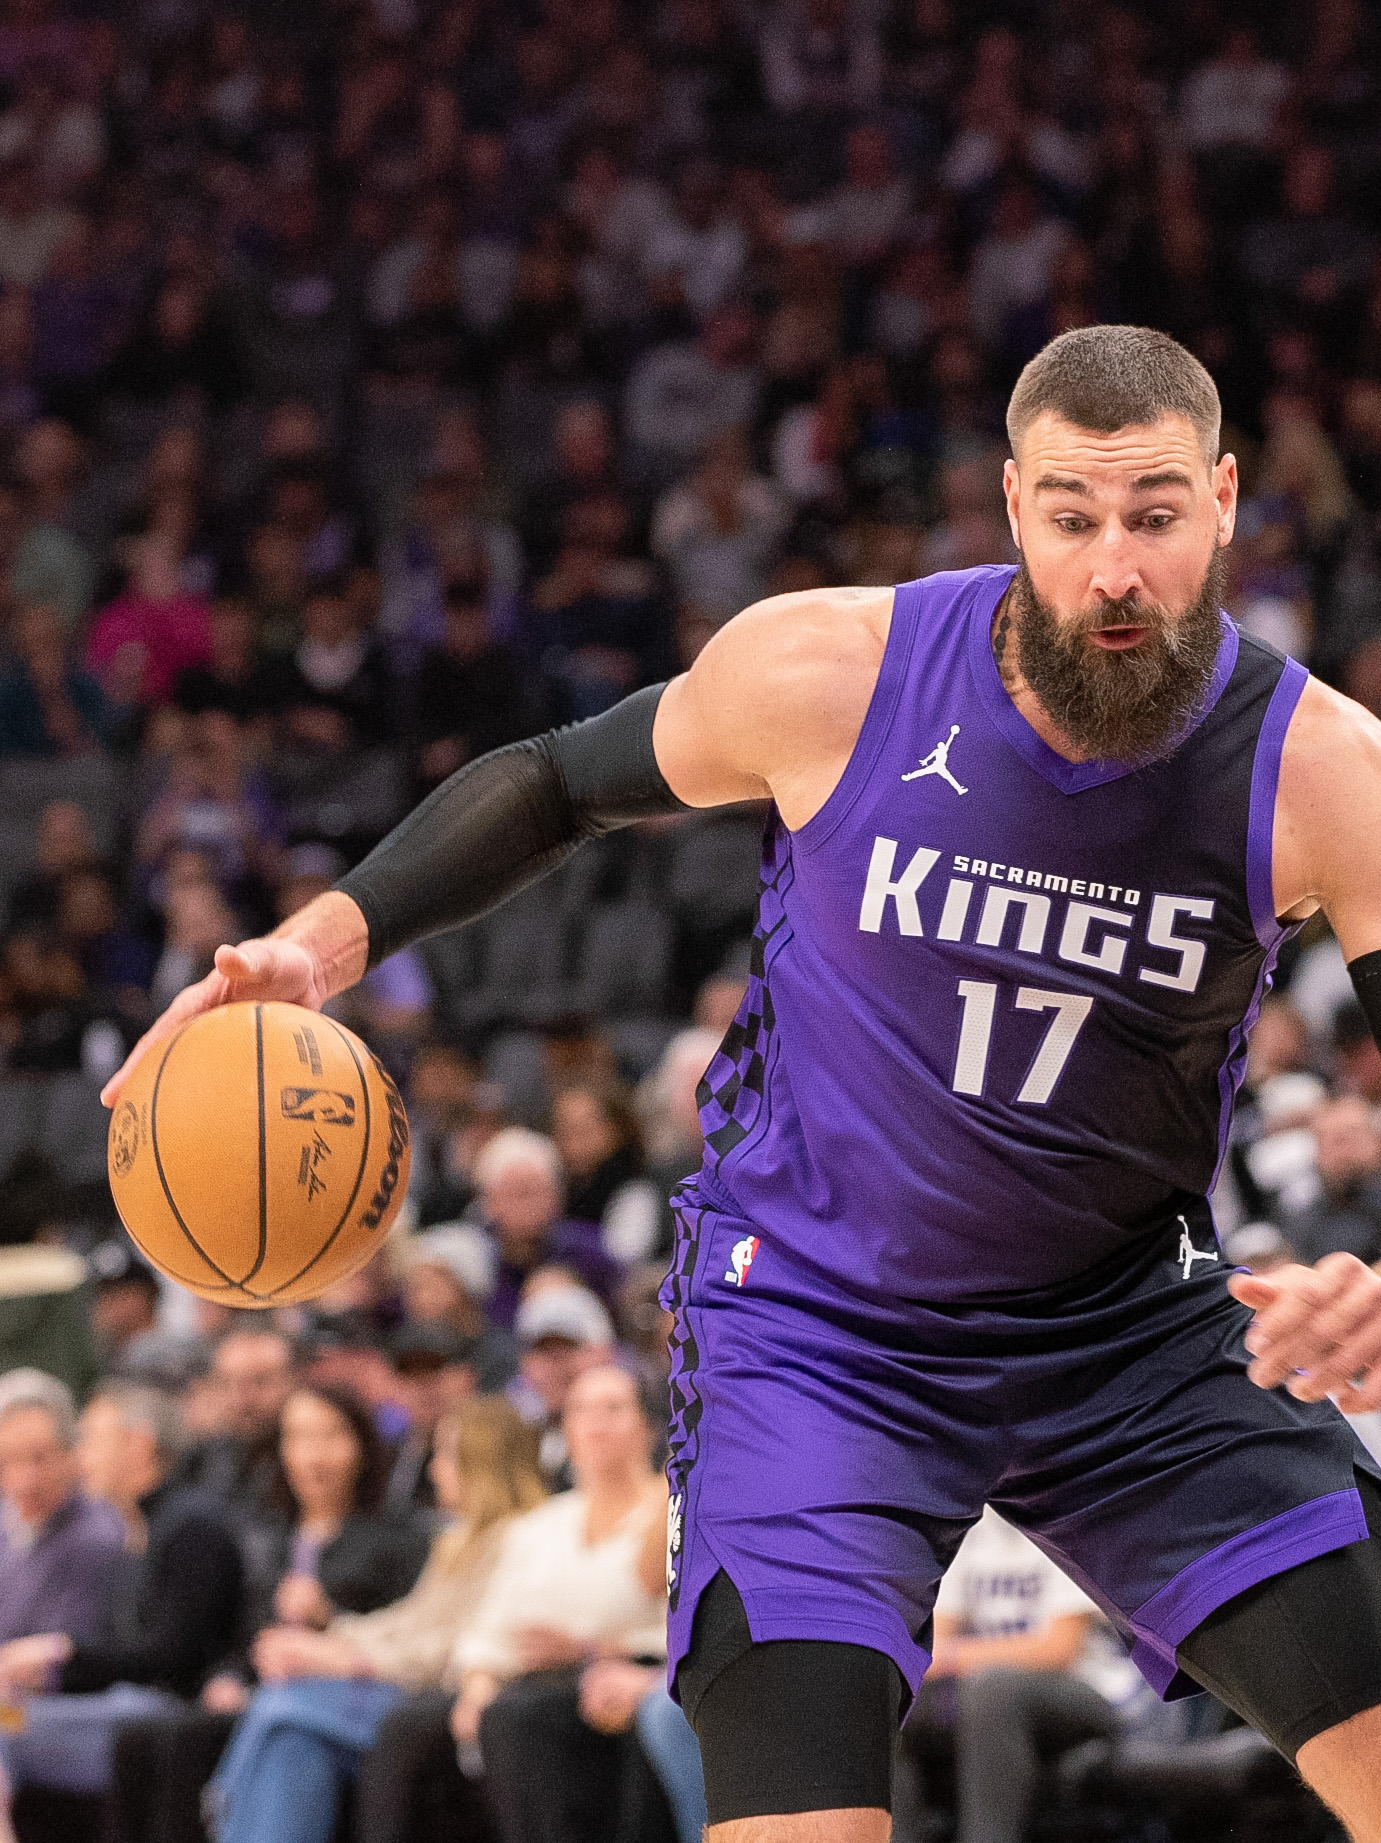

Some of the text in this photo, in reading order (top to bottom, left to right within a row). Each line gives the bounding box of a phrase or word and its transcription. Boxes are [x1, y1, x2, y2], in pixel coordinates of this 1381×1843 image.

[858, 835, 1215, 993] KINGS
[952, 855, 1141, 906] SACRAMENTO
[952, 979, 1094, 1104] 17
